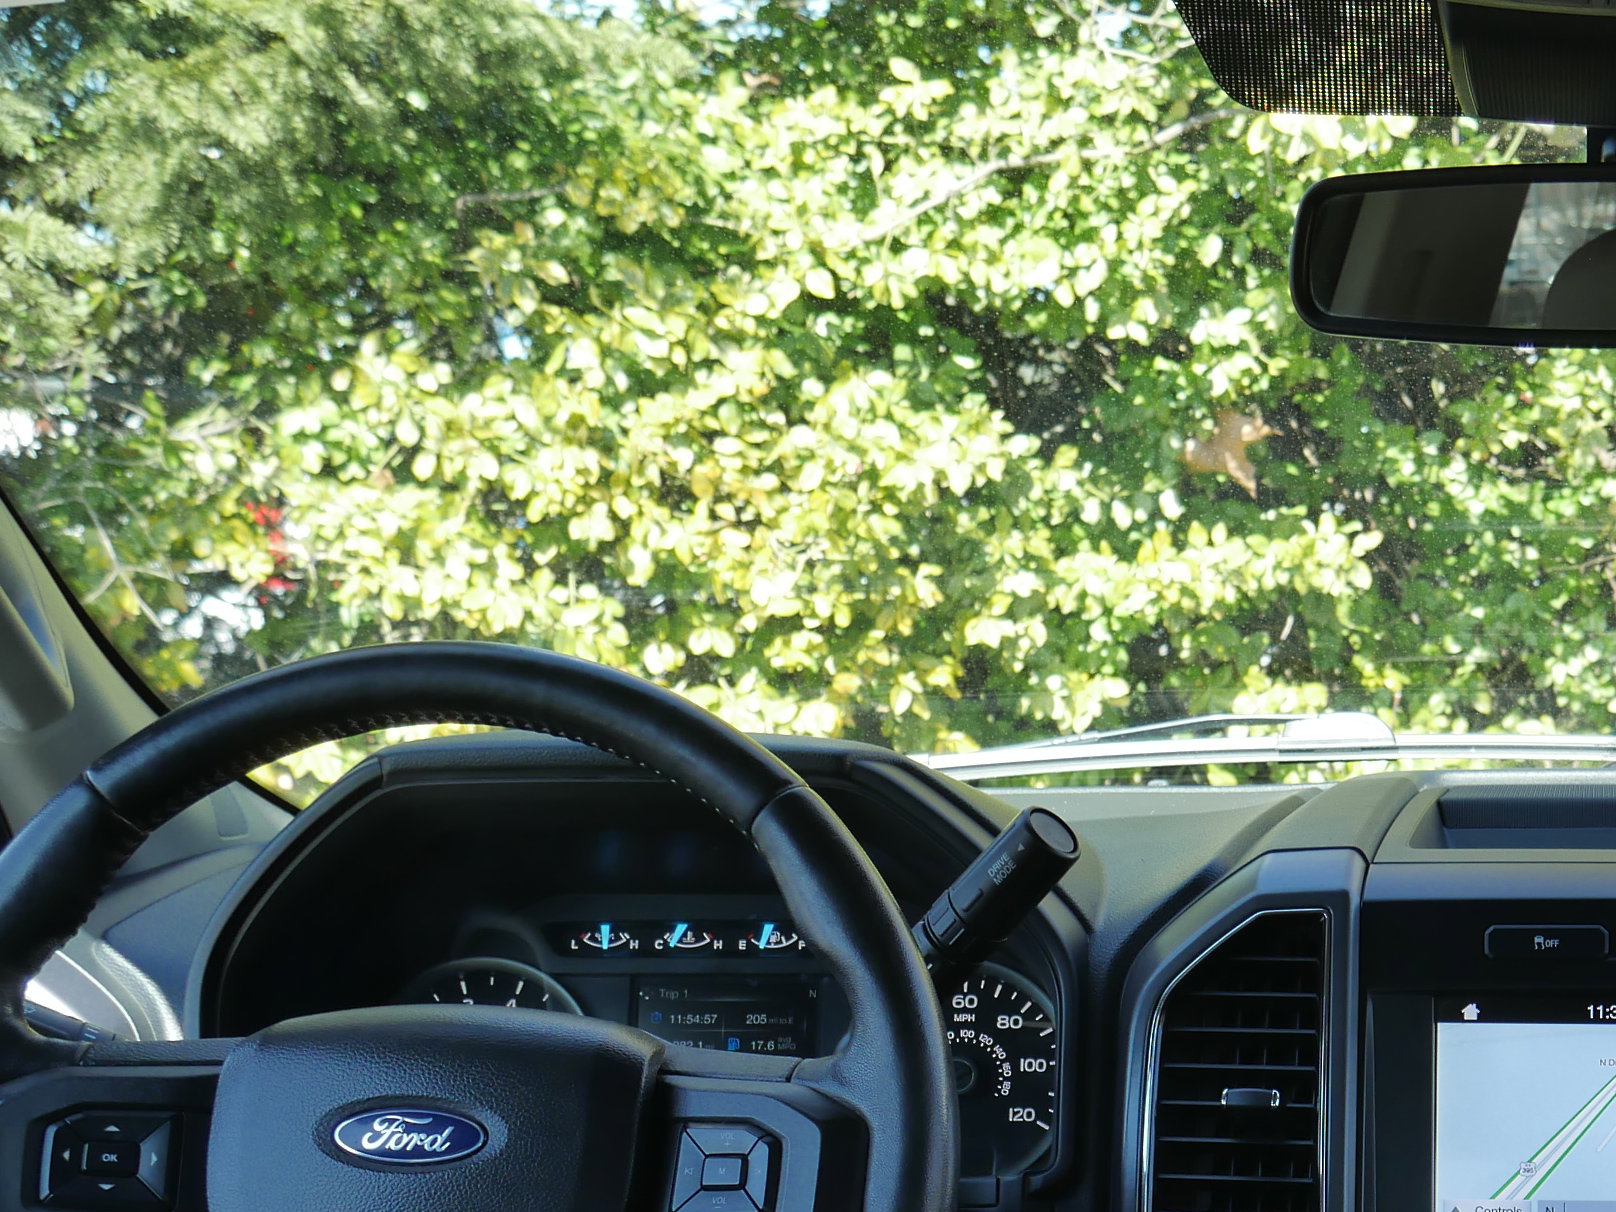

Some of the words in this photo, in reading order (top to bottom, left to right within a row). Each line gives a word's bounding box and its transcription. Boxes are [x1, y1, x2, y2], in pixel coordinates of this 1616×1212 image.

[987, 851, 1011, 877] DRIVE
[993, 860, 1017, 886] MODE
[629, 939, 639, 950] H
[654, 939, 664, 949] C
[713, 939, 723, 950] H
[739, 940, 746, 950] E
[1545, 939, 1559, 949] OFF
[952, 995, 978, 1009] 60
[669, 1014, 718, 1025] 11:54:57
[746, 1014, 767, 1025] 205
[954, 1014, 975, 1023] MPH
[996, 1015, 1023, 1029] 80
[960, 1029, 975, 1039] 100
[978, 1033, 994, 1046] 120
[751, 1041, 775, 1050] 17.6
[1020, 1058, 1047, 1073] 100
[1600, 1059, 1607, 1067] N
[1009, 1107, 1036, 1122] 120
[361, 1114, 454, 1154] Ford
[102, 1153, 118, 1162] OK
[712, 1197, 726, 1205] VOL
